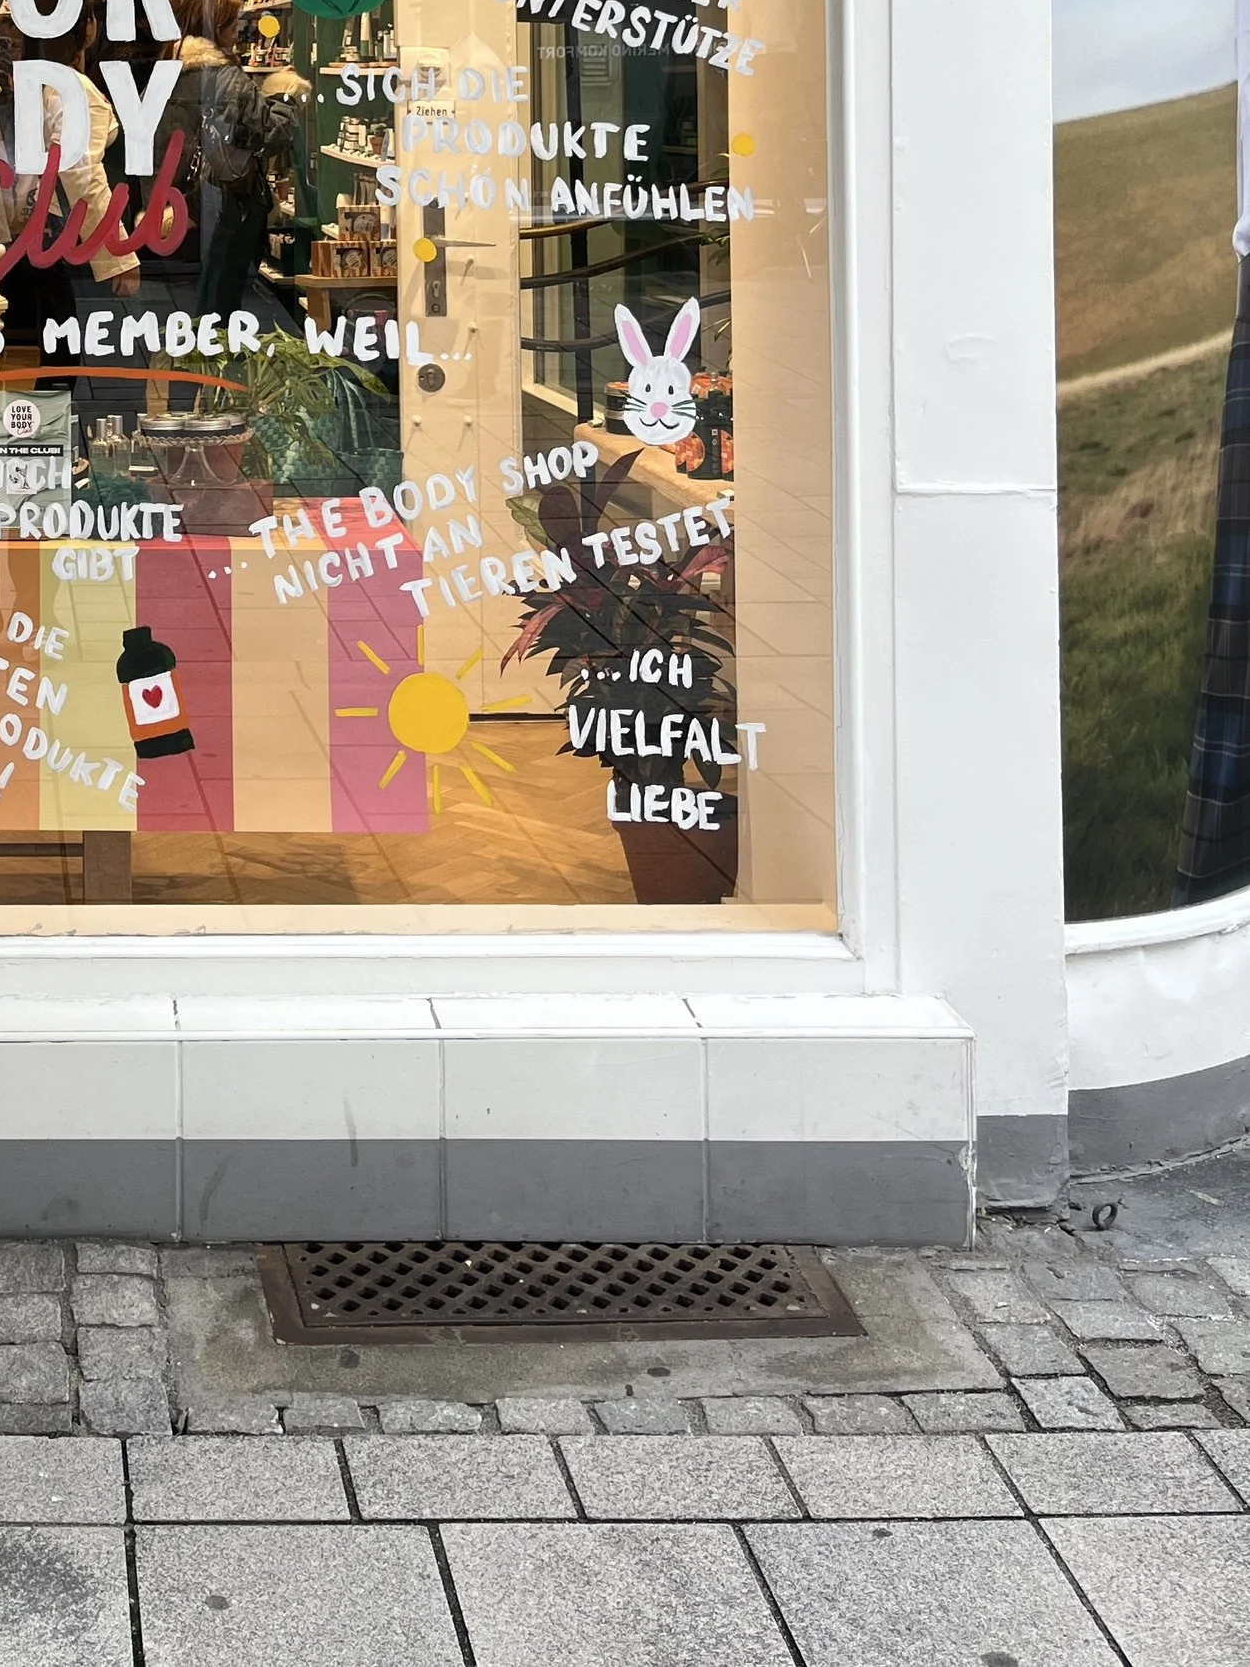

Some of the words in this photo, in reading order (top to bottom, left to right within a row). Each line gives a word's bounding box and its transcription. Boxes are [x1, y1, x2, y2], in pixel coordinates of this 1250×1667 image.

[458, 66, 529, 103] DIE
[416, 105, 448, 117] Ziehen
[402, 113, 650, 164] PRODUKTE
[375, 162, 530, 212] SCHÖN
[551, 174, 754, 223] ANFÜHLEN
[43, 310, 275, 358] MEMBER,
[10, 413, 32, 421] YOUR
[10, 421, 32, 429] BODY
[11, 405, 32, 413] LOVE
[249, 497, 347, 560] THE
[358, 464, 477, 529] BODY
[499, 441, 599, 496] SHOP
[51, 545, 140, 583] GIBT
[273, 533, 404, 605] NICHT
[422, 513, 483, 564] AN
[399, 547, 578, 618] TIEREN
[581, 497, 733, 570] TESTET
[7, 610, 71, 662] DIE
[567, 707, 767, 771] VIELFALT
[606, 779, 723, 831] LIEBE
